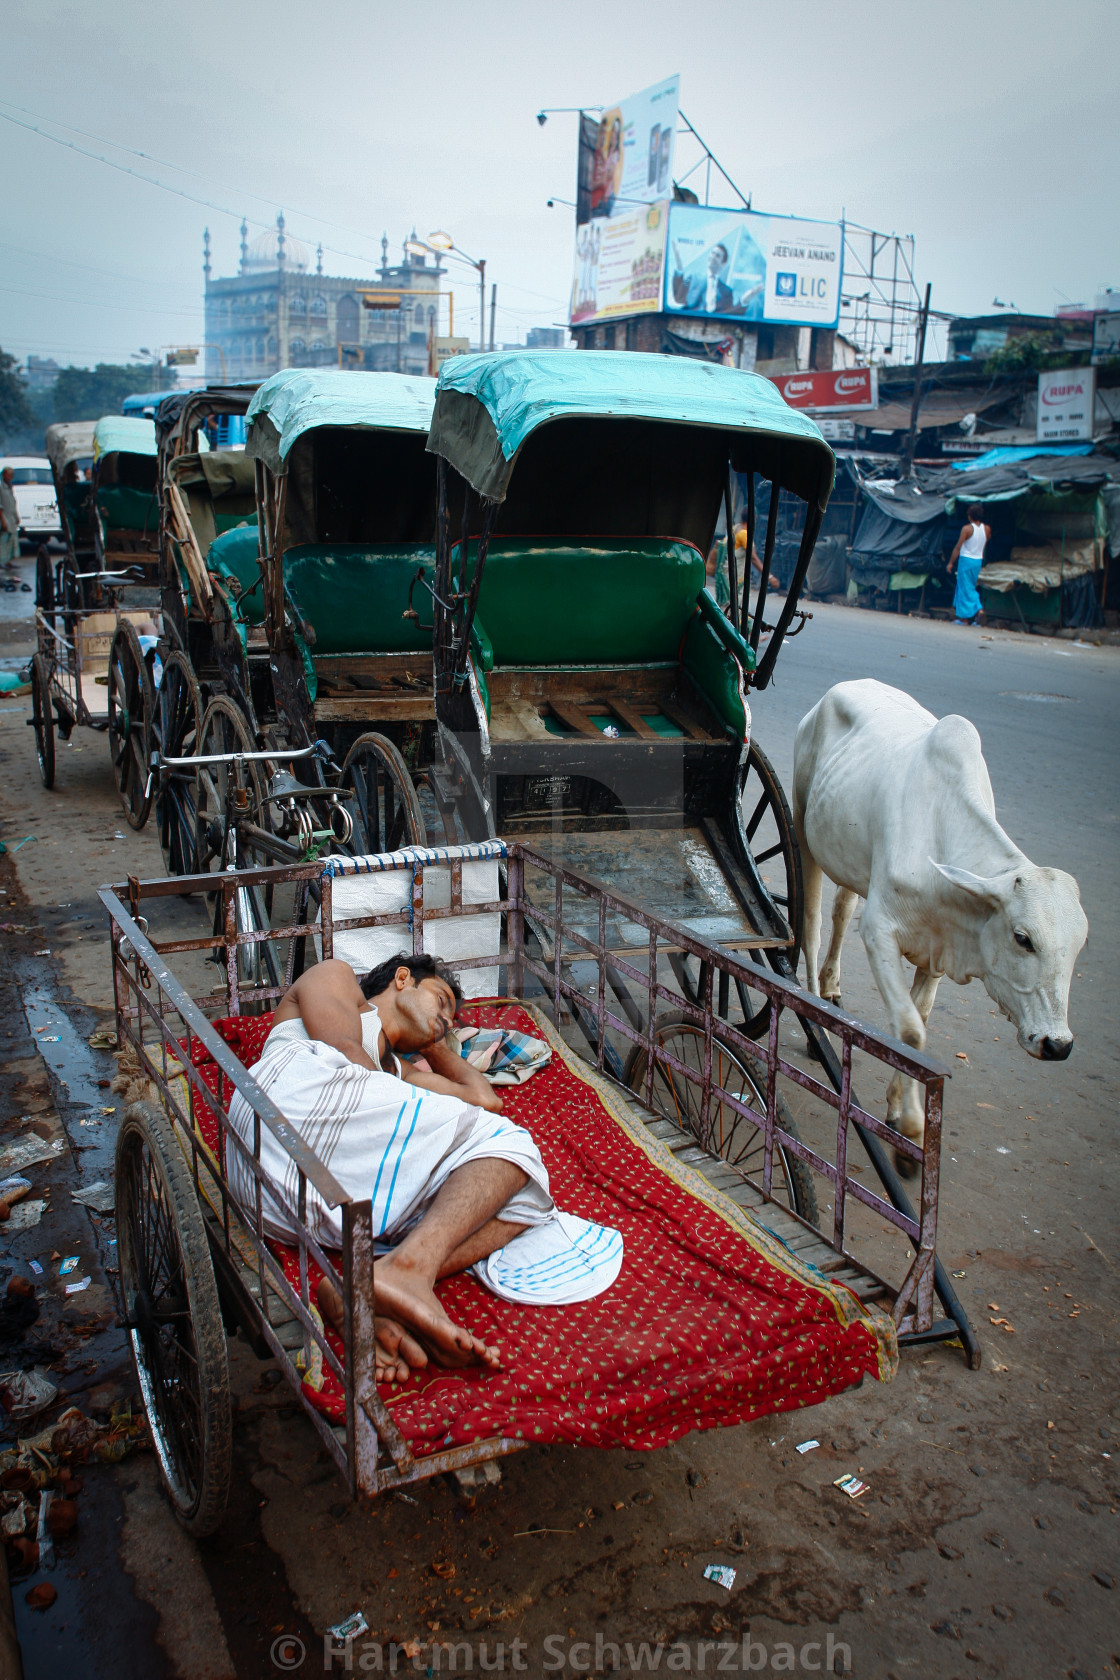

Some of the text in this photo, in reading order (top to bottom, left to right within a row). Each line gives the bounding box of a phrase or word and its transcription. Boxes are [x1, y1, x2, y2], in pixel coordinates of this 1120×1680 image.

[772, 245, 836, 263] JEEVAN ANAND
[800, 276, 827, 299] LIC
[790, 380, 814, 391] RUPA
[841, 376, 867, 387] RUPA
[1049, 384, 1084, 397] RUPA
